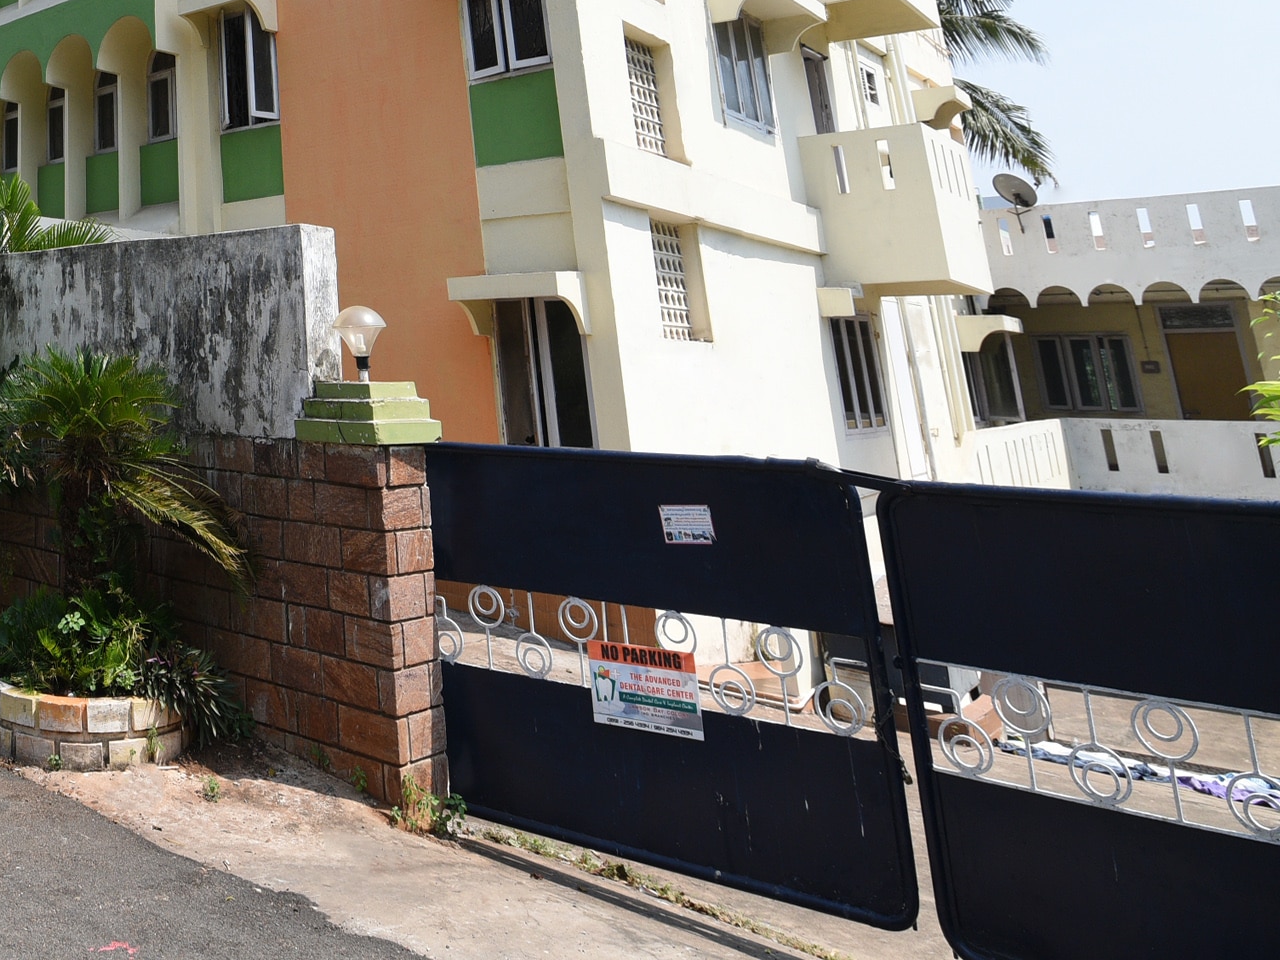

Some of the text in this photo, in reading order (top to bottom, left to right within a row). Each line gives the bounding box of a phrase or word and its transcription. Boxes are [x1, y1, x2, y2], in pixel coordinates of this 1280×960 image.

[600, 644, 682, 669] NO PARKING
[630, 672, 681, 687] THE ADVANCED
[620, 682, 694, 700] DENTAL CARE CENTER
